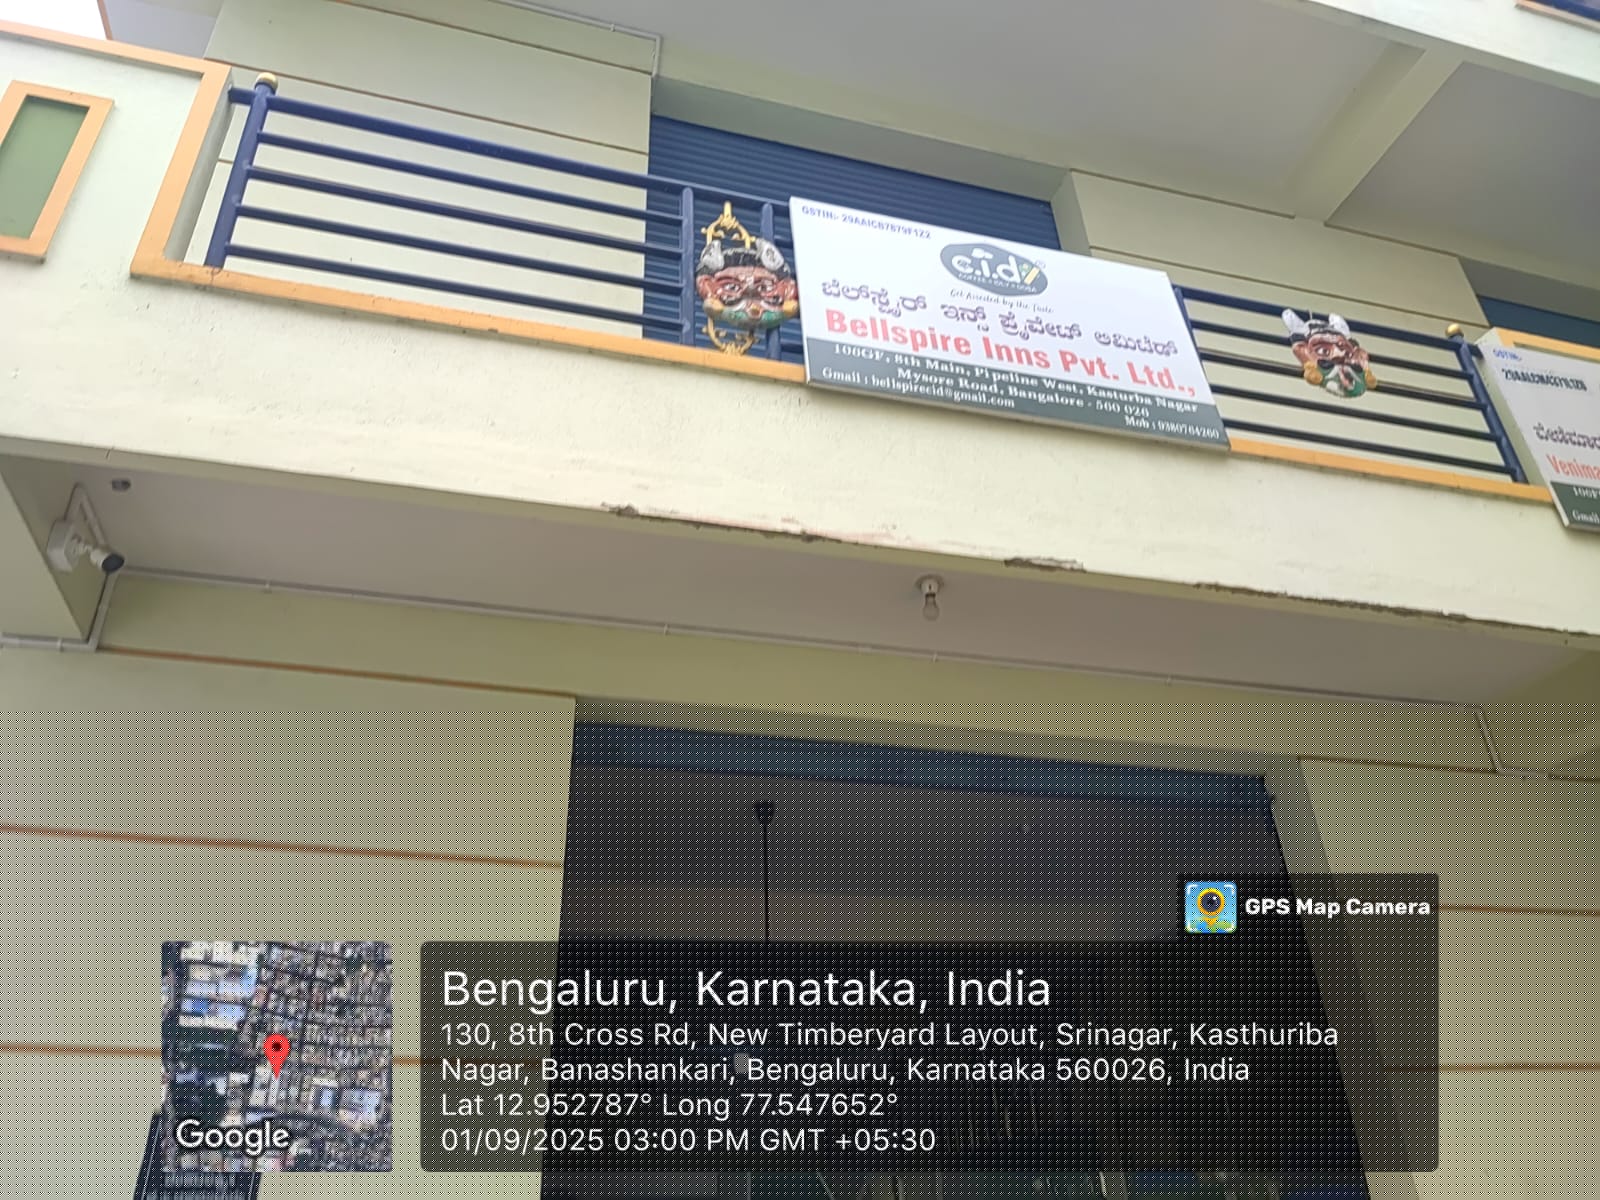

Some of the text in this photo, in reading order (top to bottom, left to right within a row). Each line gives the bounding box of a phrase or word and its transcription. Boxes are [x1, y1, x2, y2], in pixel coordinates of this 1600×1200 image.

[825, 308, 1197, 398] Bellspire Inns Pvt. Ltd.,
[822, 366, 862, 382] Gmail
[894, 355, 921, 369] 8th
[925, 359, 971, 378] Main,
[1042, 376, 1084, 396] West,
[1086, 385, 1153, 407] Kasturba
[1155, 395, 1199, 414] Nagar
[897, 367, 954, 389] Mysore
[958, 376, 1006, 397] Road,
[1007, 385, 1085, 408] Bangalore
[1124, 414, 1150, 430] Mob
